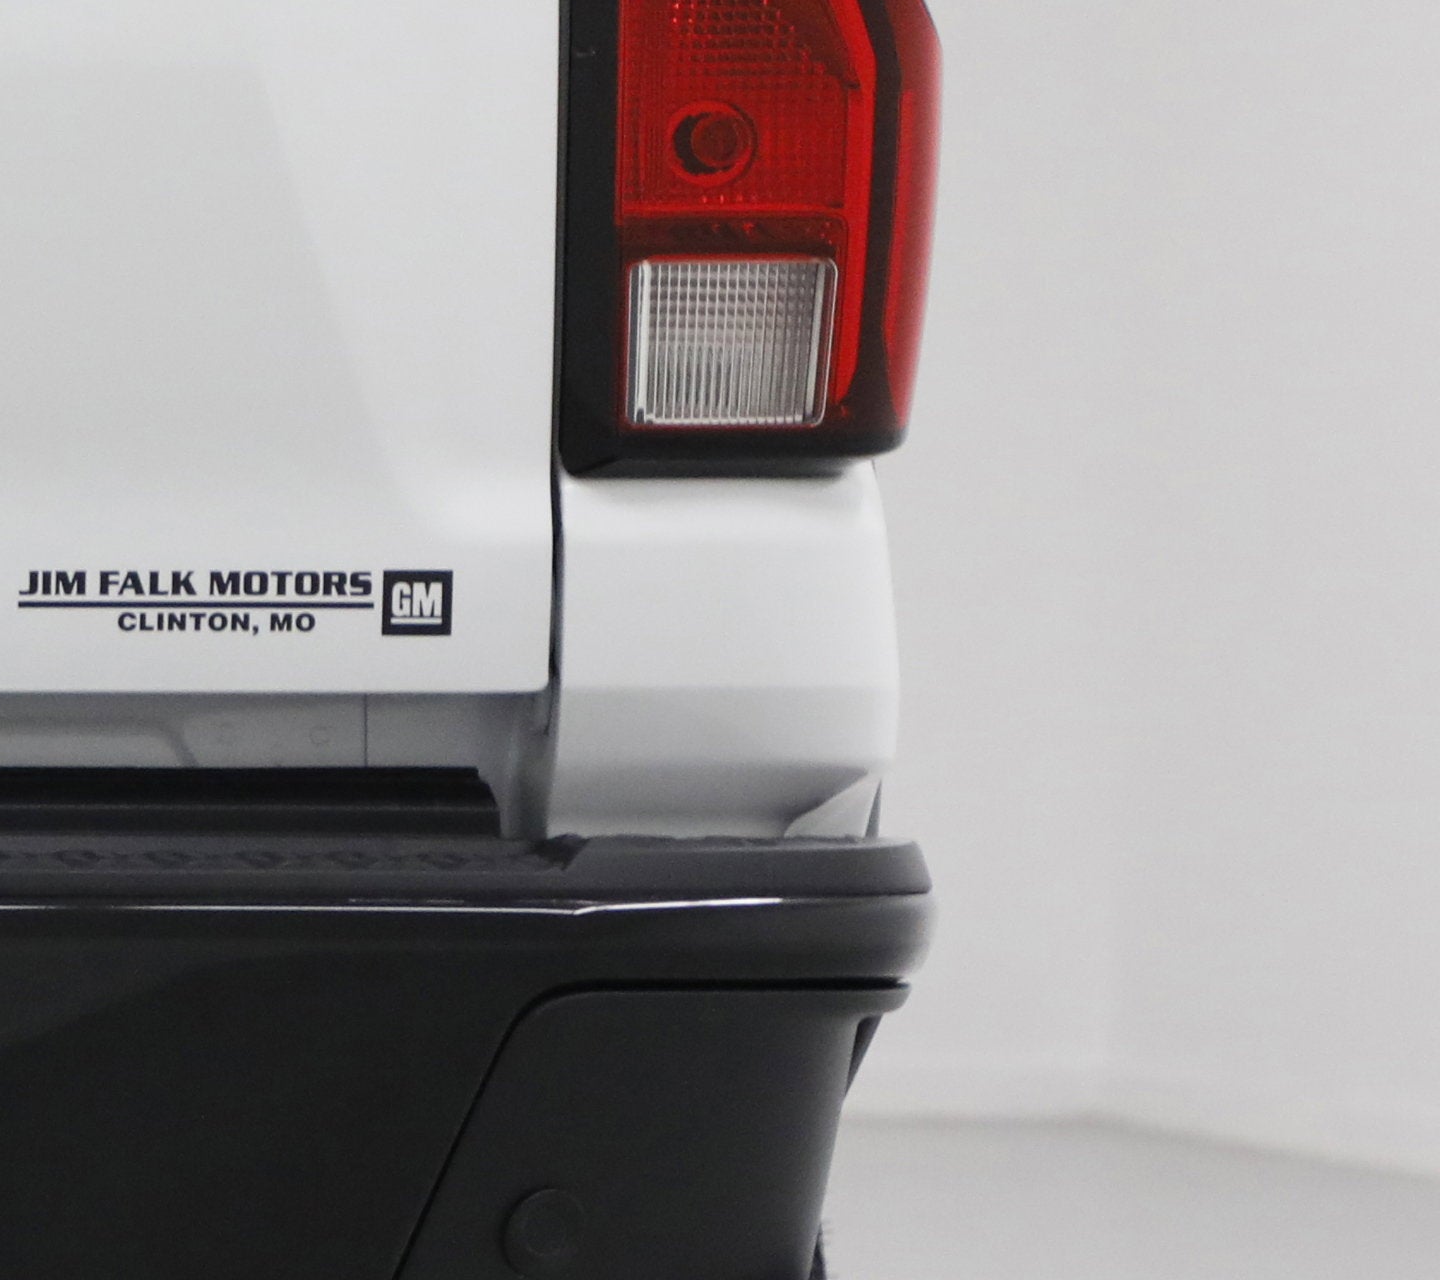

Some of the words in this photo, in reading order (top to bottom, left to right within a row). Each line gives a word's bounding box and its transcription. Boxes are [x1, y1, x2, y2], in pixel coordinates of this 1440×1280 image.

[18, 570, 87, 597] JIM
[99, 570, 197, 597] FALK
[209, 570, 373, 597] MOTORS
[389, 580, 444, 619] GM
[117, 612, 260, 636] CLINTON,
[270, 612, 316, 633] MO
